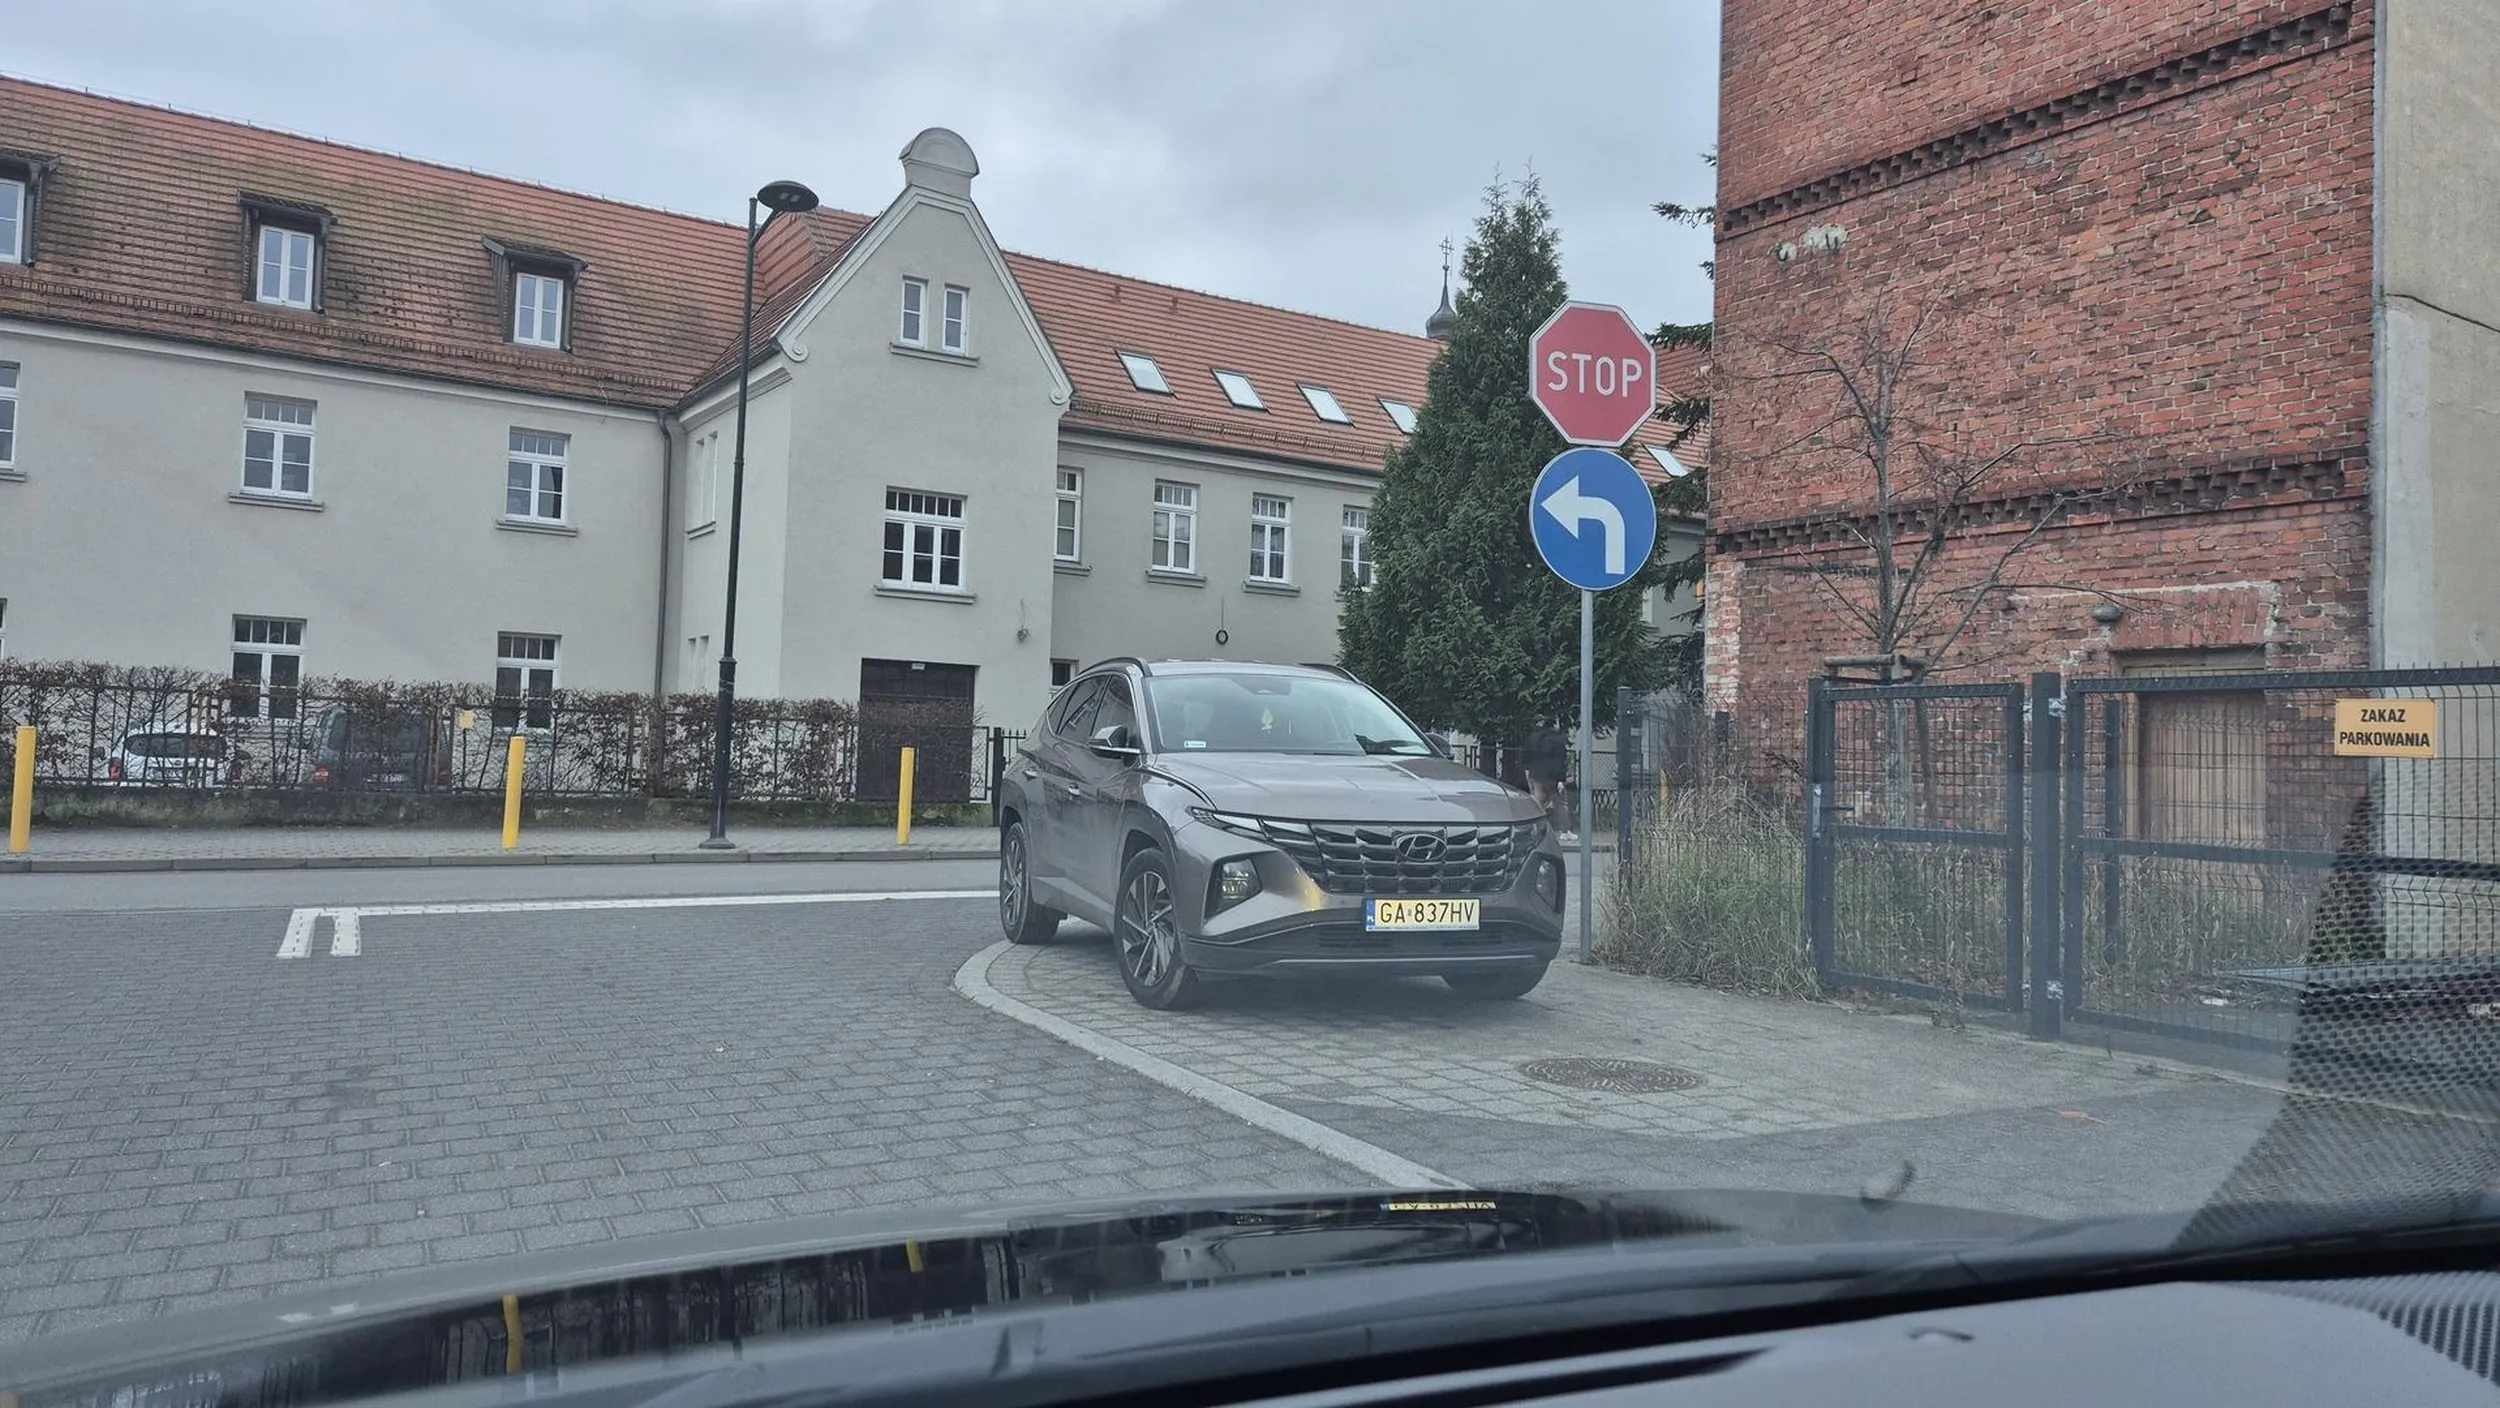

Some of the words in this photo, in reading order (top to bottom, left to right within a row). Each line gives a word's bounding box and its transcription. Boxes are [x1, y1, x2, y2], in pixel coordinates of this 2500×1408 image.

[1547, 350, 1643, 398] STOP
[2360, 708, 2406, 723] ZAKAZ
[2339, 731, 2431, 748] PARKOWANIA
[1380, 902, 1405, 923] GA
[1414, 902, 1475, 923] 837HV
